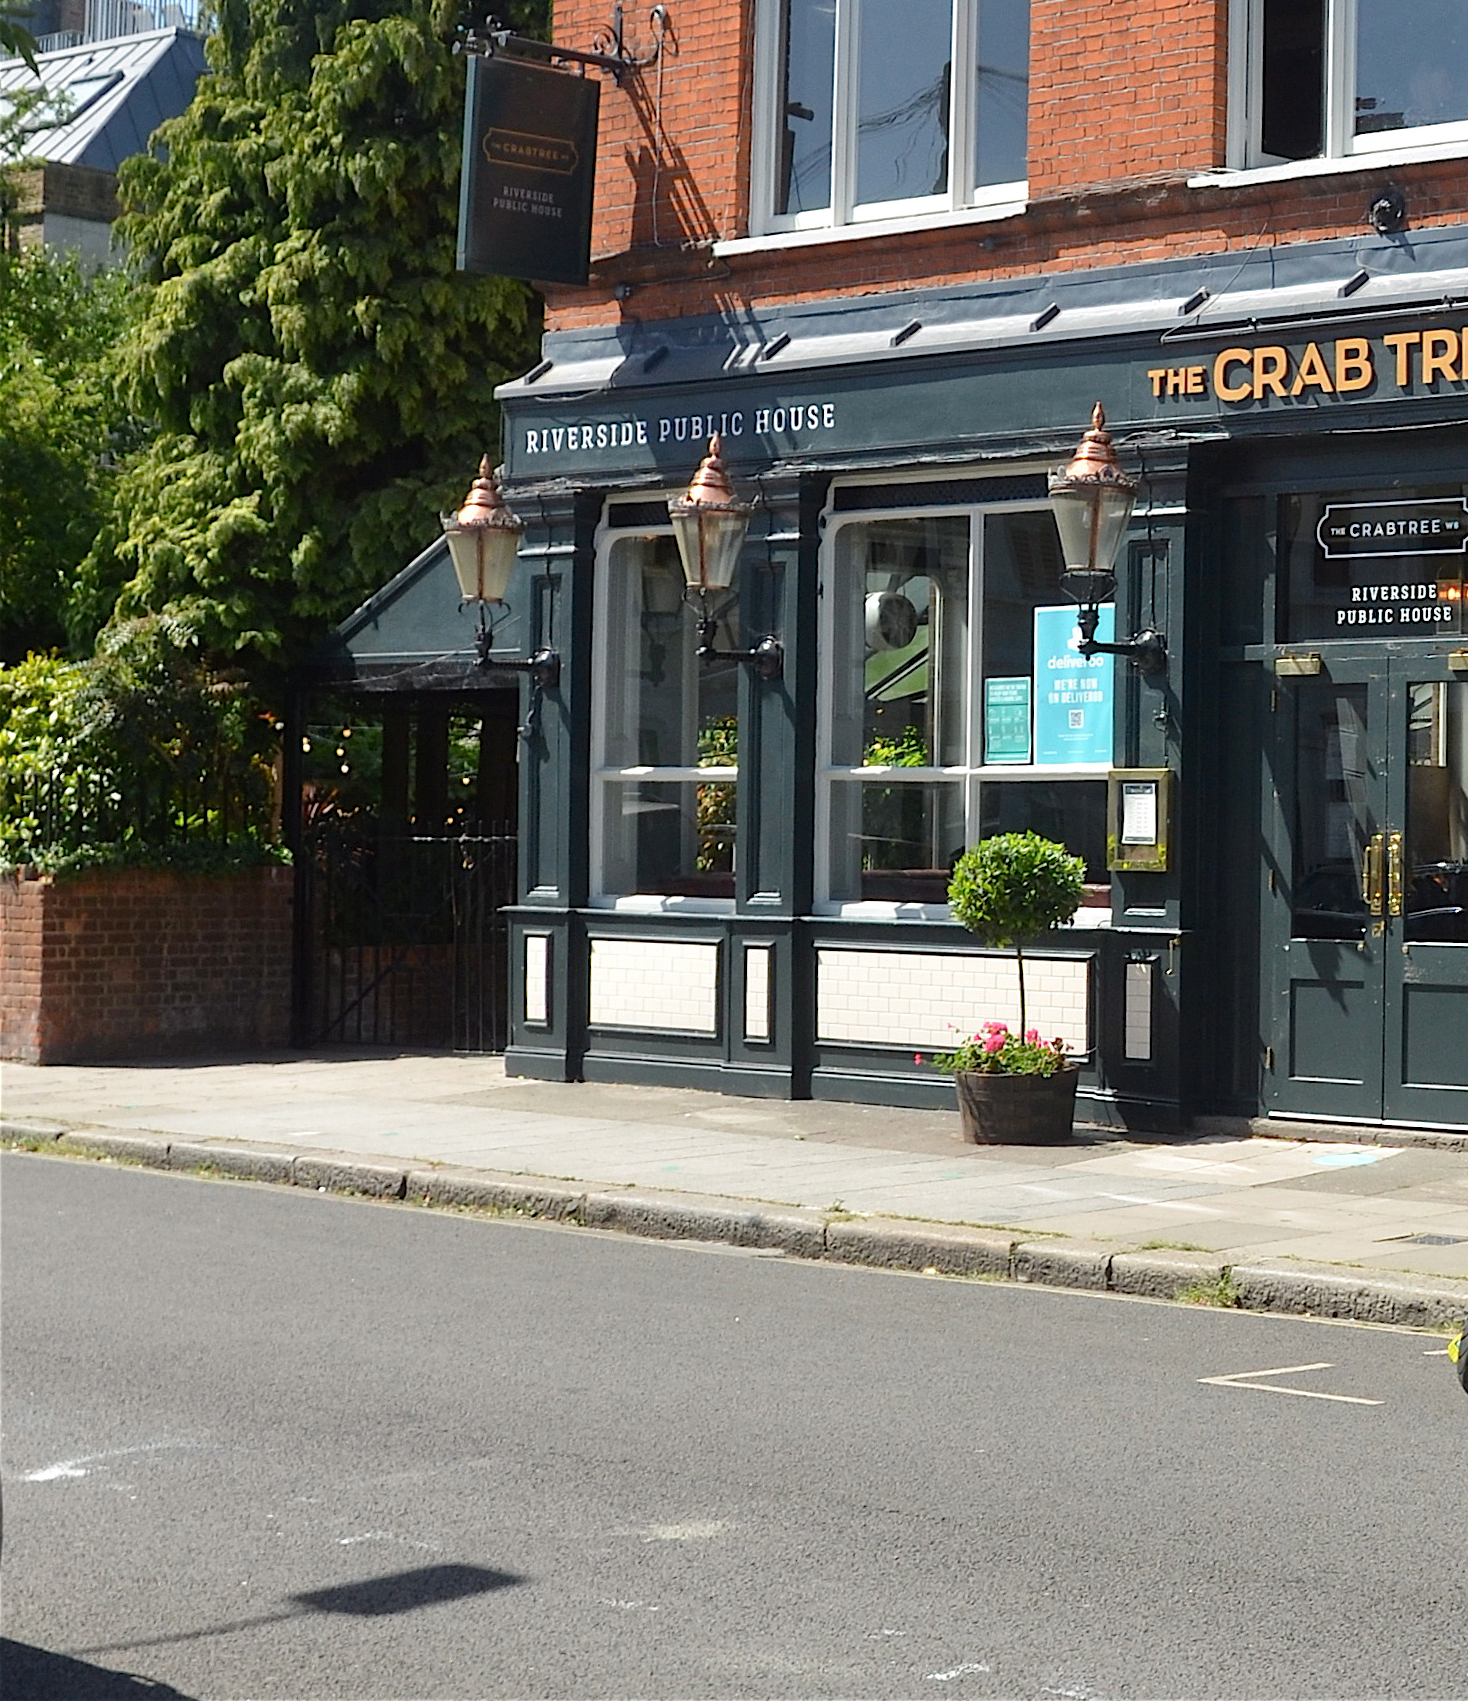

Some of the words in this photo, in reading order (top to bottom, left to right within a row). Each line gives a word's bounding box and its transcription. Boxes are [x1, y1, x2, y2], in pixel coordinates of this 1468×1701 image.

[503, 143, 559, 160] CRABTREE
[503, 186, 554, 204] RIVERSIDE
[493, 197, 528, 213] PUBLIC
[531, 204, 562, 218] HOUSE
[1147, 365, 1206, 397] THE
[1213, 337, 1374, 402] CRAB
[526, 420, 648, 454] RIVERSIDE
[658, 411, 744, 443] PUBLIC
[754, 402, 836, 435] HOUSE
[1330, 527, 1346, 537] THE
[1349, 519, 1441, 538] CRABTREE
[1351, 584, 1437, 602] RIVERSIDE
[1336, 608, 1394, 625] PUBLIC
[1400, 606, 1453, 623] HOUSE
